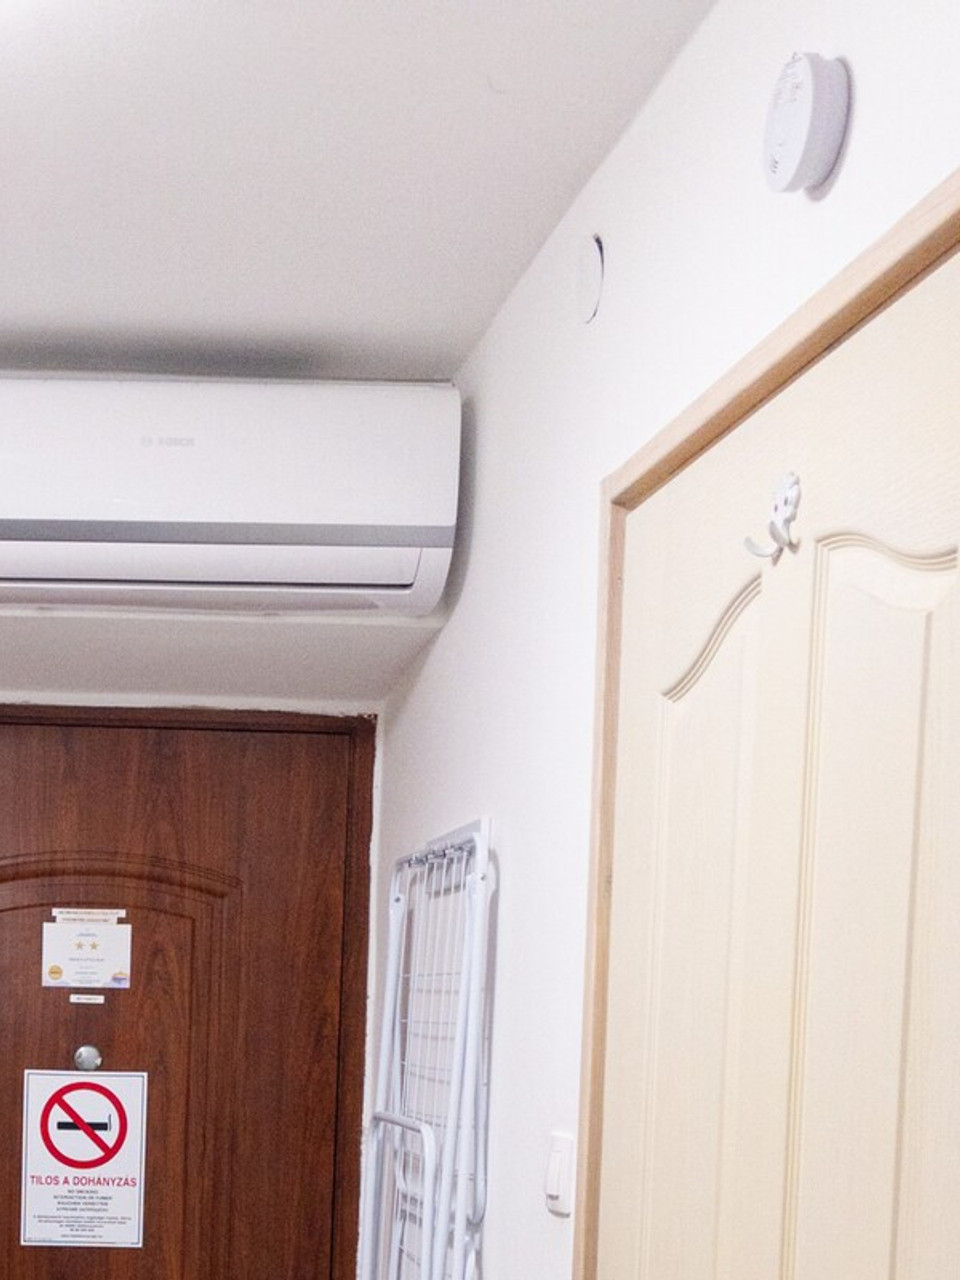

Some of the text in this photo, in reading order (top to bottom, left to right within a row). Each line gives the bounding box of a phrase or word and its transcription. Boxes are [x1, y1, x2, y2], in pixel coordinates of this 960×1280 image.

[30, 1174, 137, 1187] TILOS A DOHÁNYZÁS
